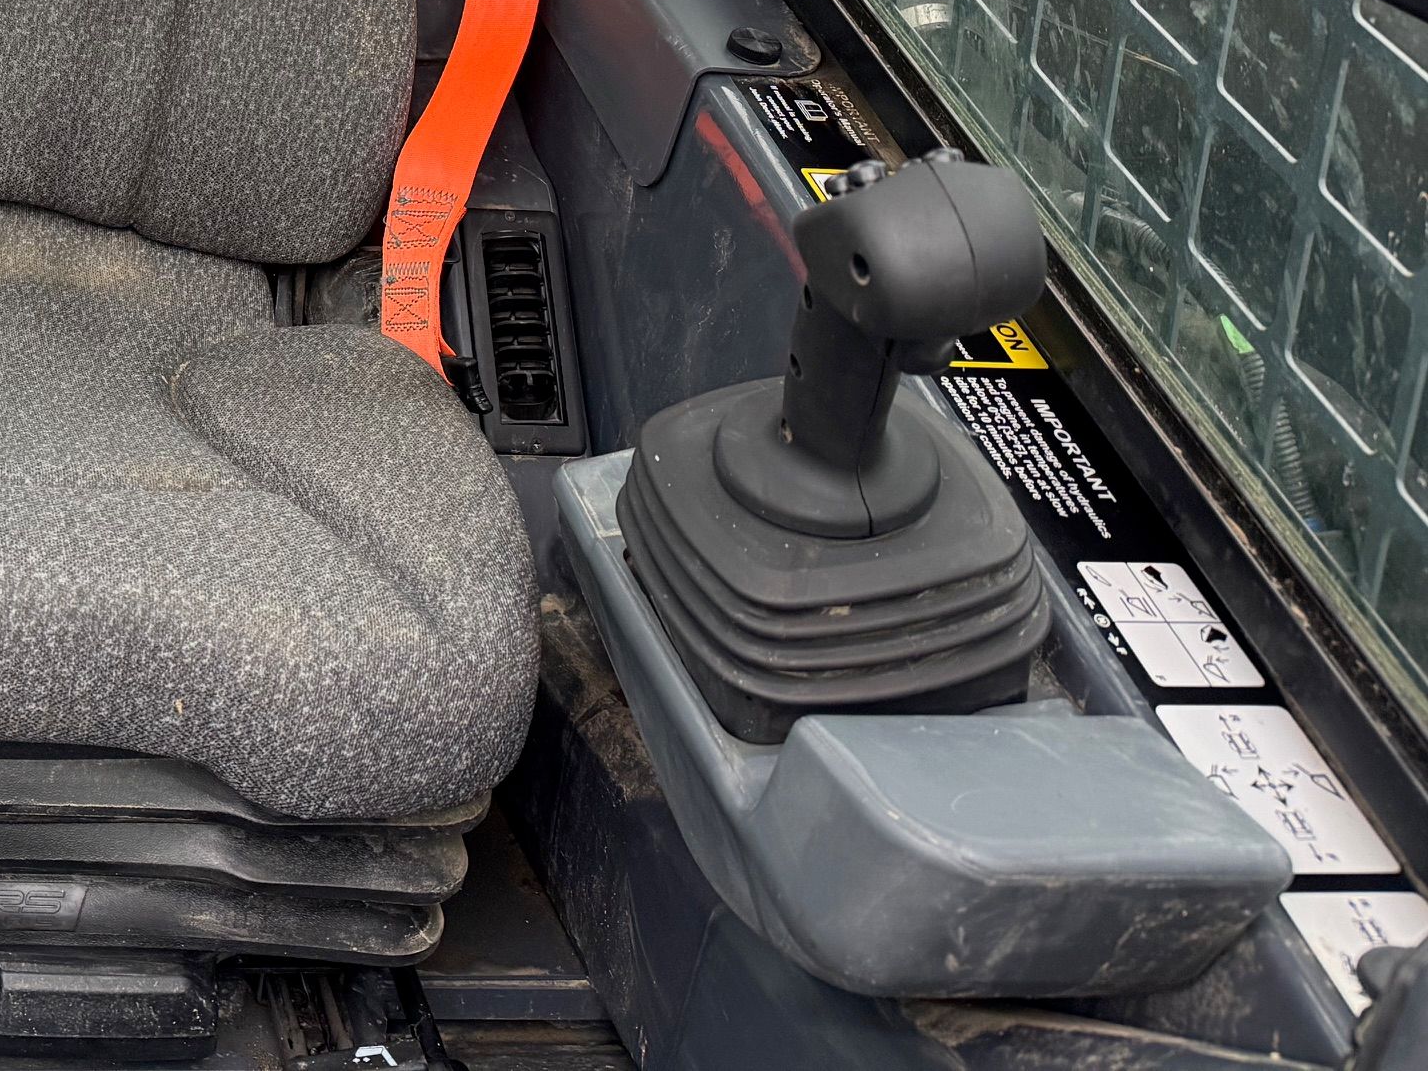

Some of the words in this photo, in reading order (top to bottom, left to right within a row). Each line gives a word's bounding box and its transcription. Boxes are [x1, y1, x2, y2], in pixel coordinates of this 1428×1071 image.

[748, 86, 763, 102] John
[759, 101, 775, 119] Deere
[766, 95, 786, 117] contact
[779, 117, 795, 132] your
[773, 90, 794, 111] manual
[811, 78, 843, 117] Operator's
[838, 117, 866, 146] Manual
[828, 83, 881, 143] PORTANT
[940, 375, 975, 422] operation
[971, 422, 987, 435] of
[979, 434, 1012, 480] controls.
[954, 376, 970, 395] idle
[966, 395, 982, 411] for
[978, 411, 992, 424] 10
[985, 424, 1019, 466] minutes
[1014, 466, 1042, 501] before
[967, 376, 992, 406] below
[1023, 459, 1042, 478] run
[1036, 479, 1052, 491] at
[1045, 491, 1069, 518] slow
[980, 376, 1001, 396] and
[994, 396, 1022, 432] engine,
[1019, 433, 1032, 444] in
[1027, 445, 1080, 514] temperatures
[994, 377, 1007, 390] To
[1001, 390, 1036, 428] prevent
[1030, 428, 1063, 469] damage
[1059, 469, 1075, 482] of
[1067, 482, 1112, 539] hydraulics
[1030, 398, 1117, 503] IMPORTANT
